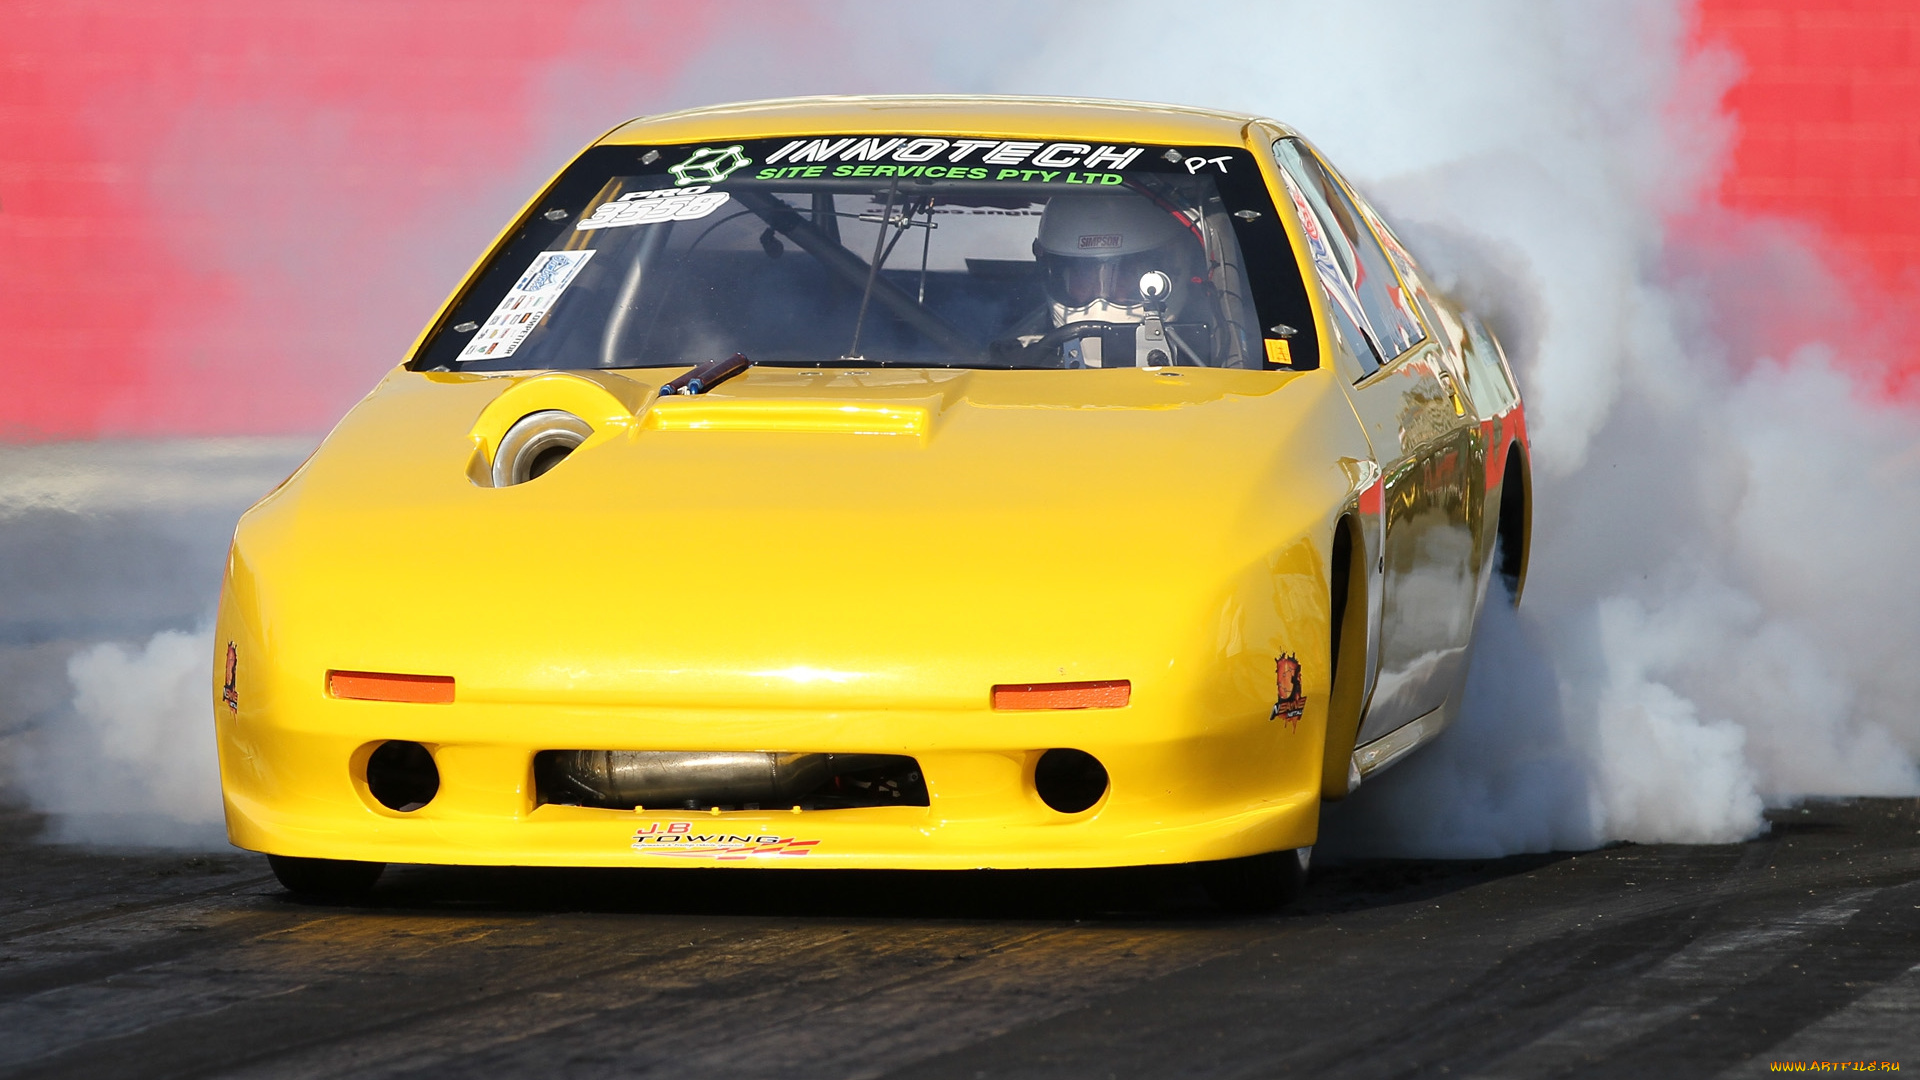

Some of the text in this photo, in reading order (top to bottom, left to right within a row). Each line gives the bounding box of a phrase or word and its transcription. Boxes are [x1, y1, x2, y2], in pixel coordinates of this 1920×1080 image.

[765, 138, 1144, 170] INNOTECH
[1184, 155, 1233, 175] PT
[756, 165, 1124, 186] SITE SERVICES PTY LTD
[617, 185, 711, 202] PRO
[1080, 235, 1120, 248] SIMPSON
[637, 823, 691, 834] J.B
[633, 835, 779, 843] TOWING
